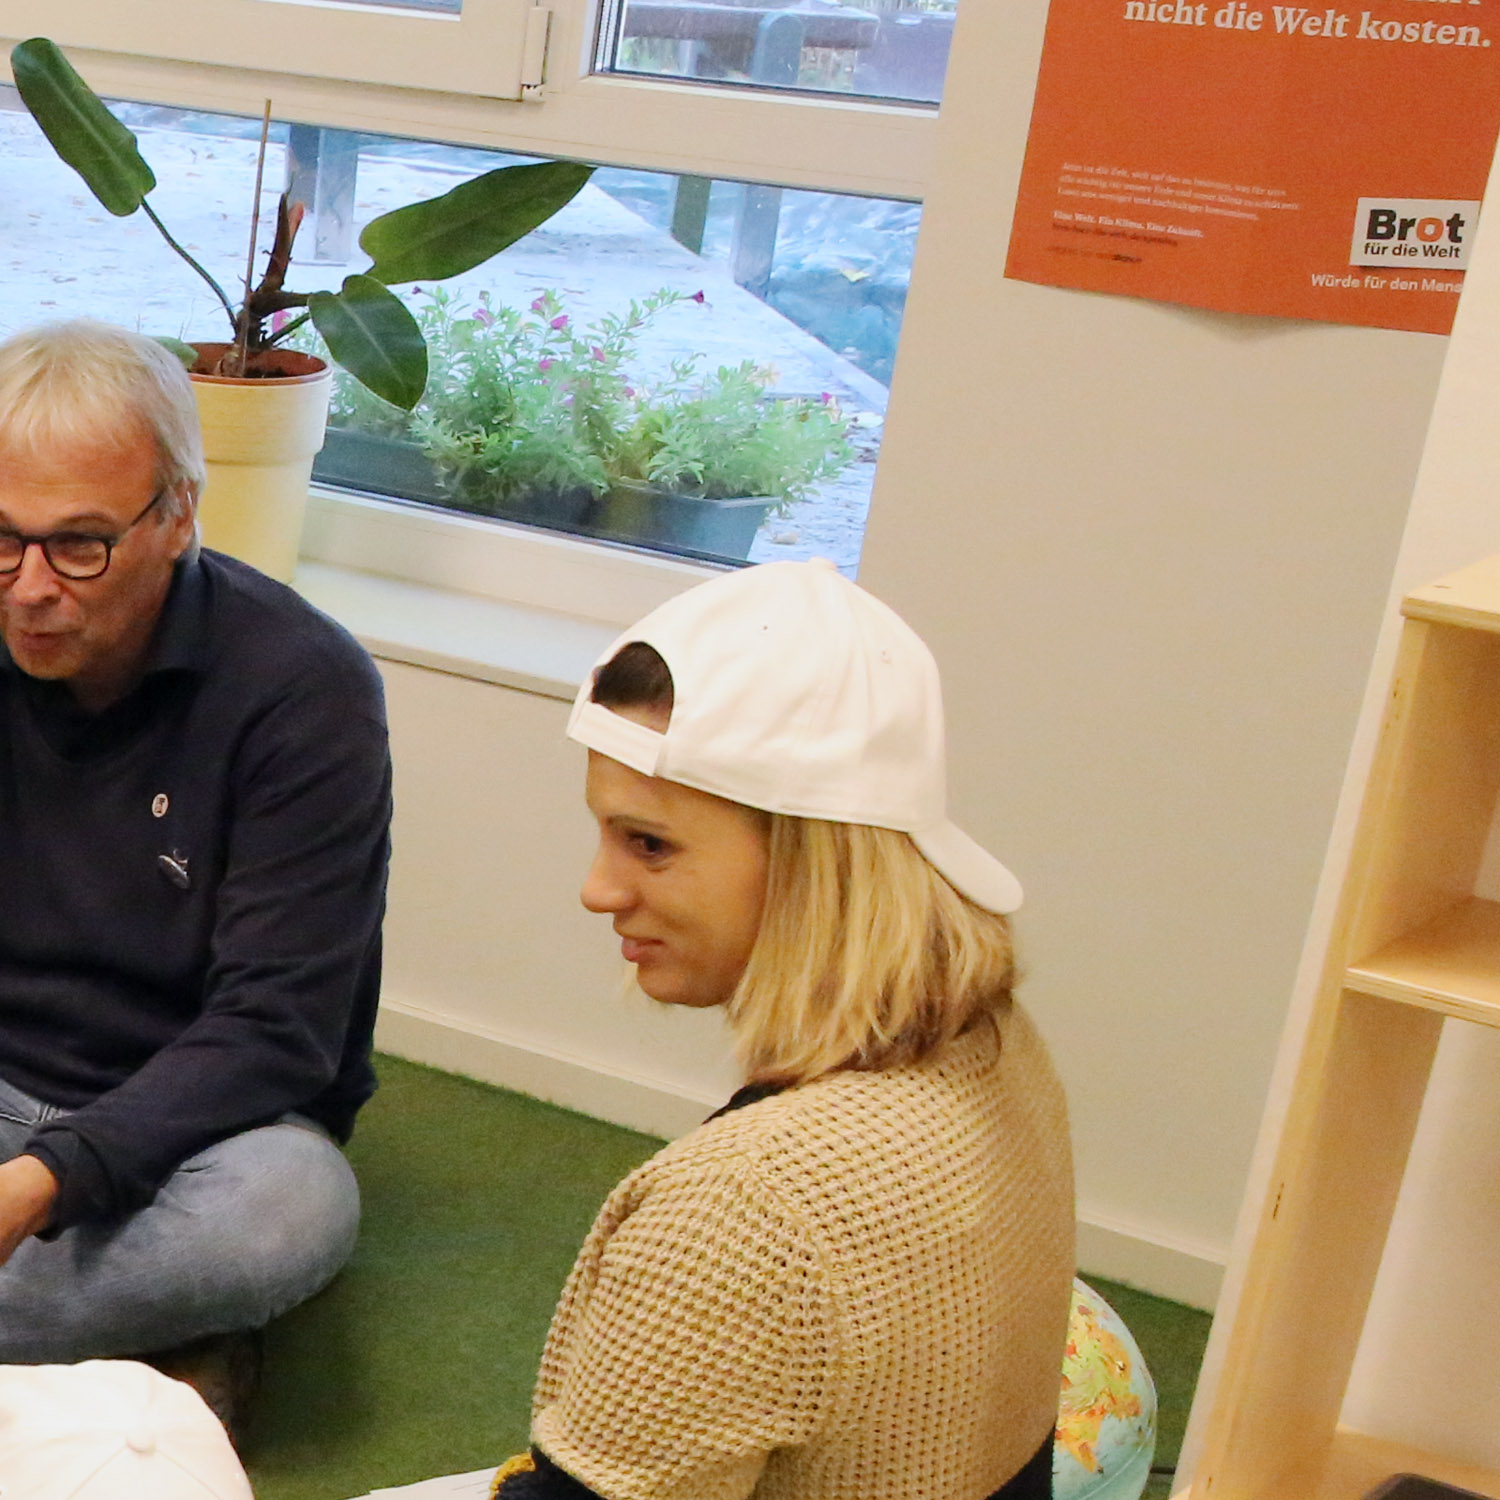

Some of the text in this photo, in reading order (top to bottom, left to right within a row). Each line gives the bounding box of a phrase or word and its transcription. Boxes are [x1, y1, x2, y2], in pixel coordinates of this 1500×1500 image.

[1123, 0, 1491, 48] nicht die Welt kosten.
[1366, 208, 1466, 243] Brot
[1364, 242, 1462, 259] für die Welt
[1311, 273, 1361, 288] Würde
[1363, 275, 1387, 290] für
[1389, 278, 1418, 291] den
